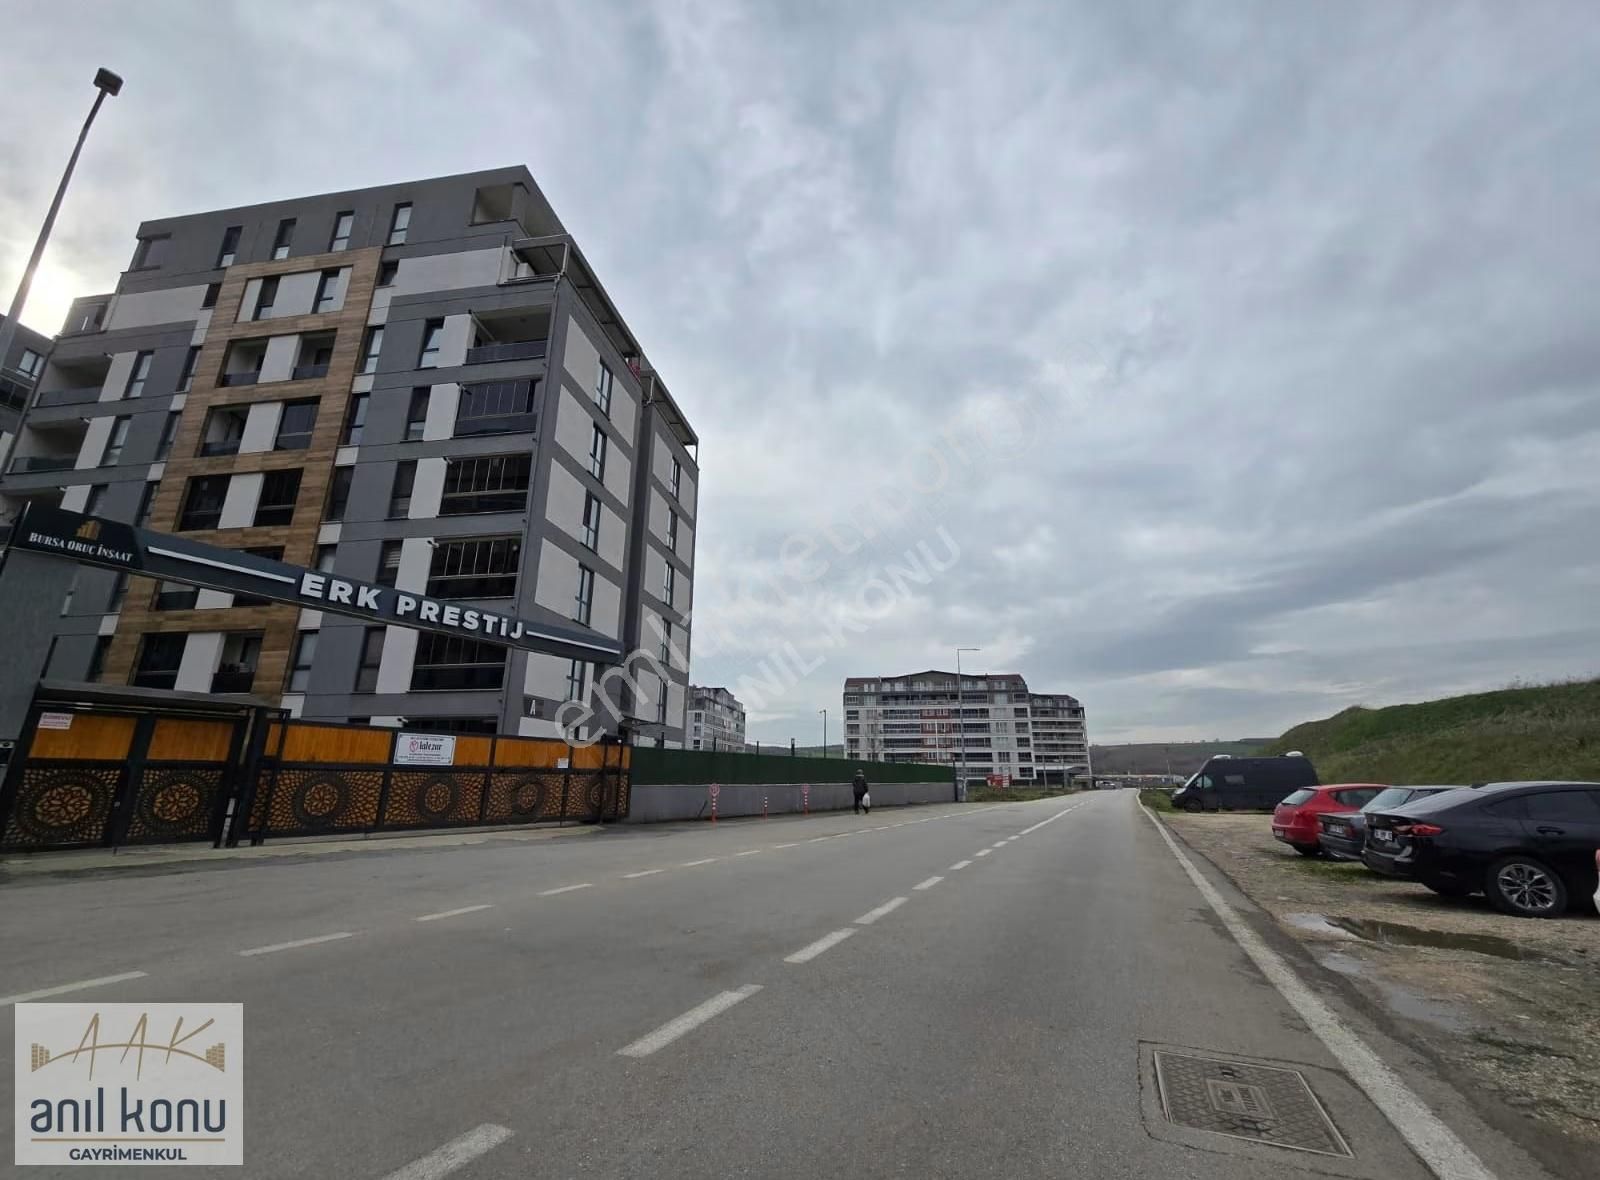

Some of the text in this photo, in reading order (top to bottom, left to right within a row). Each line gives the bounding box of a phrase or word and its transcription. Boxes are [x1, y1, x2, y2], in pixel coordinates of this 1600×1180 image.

[29, 532, 65, 549] BURSA
[299, 572, 383, 610] ERK
[529, 699, 536, 716] A
